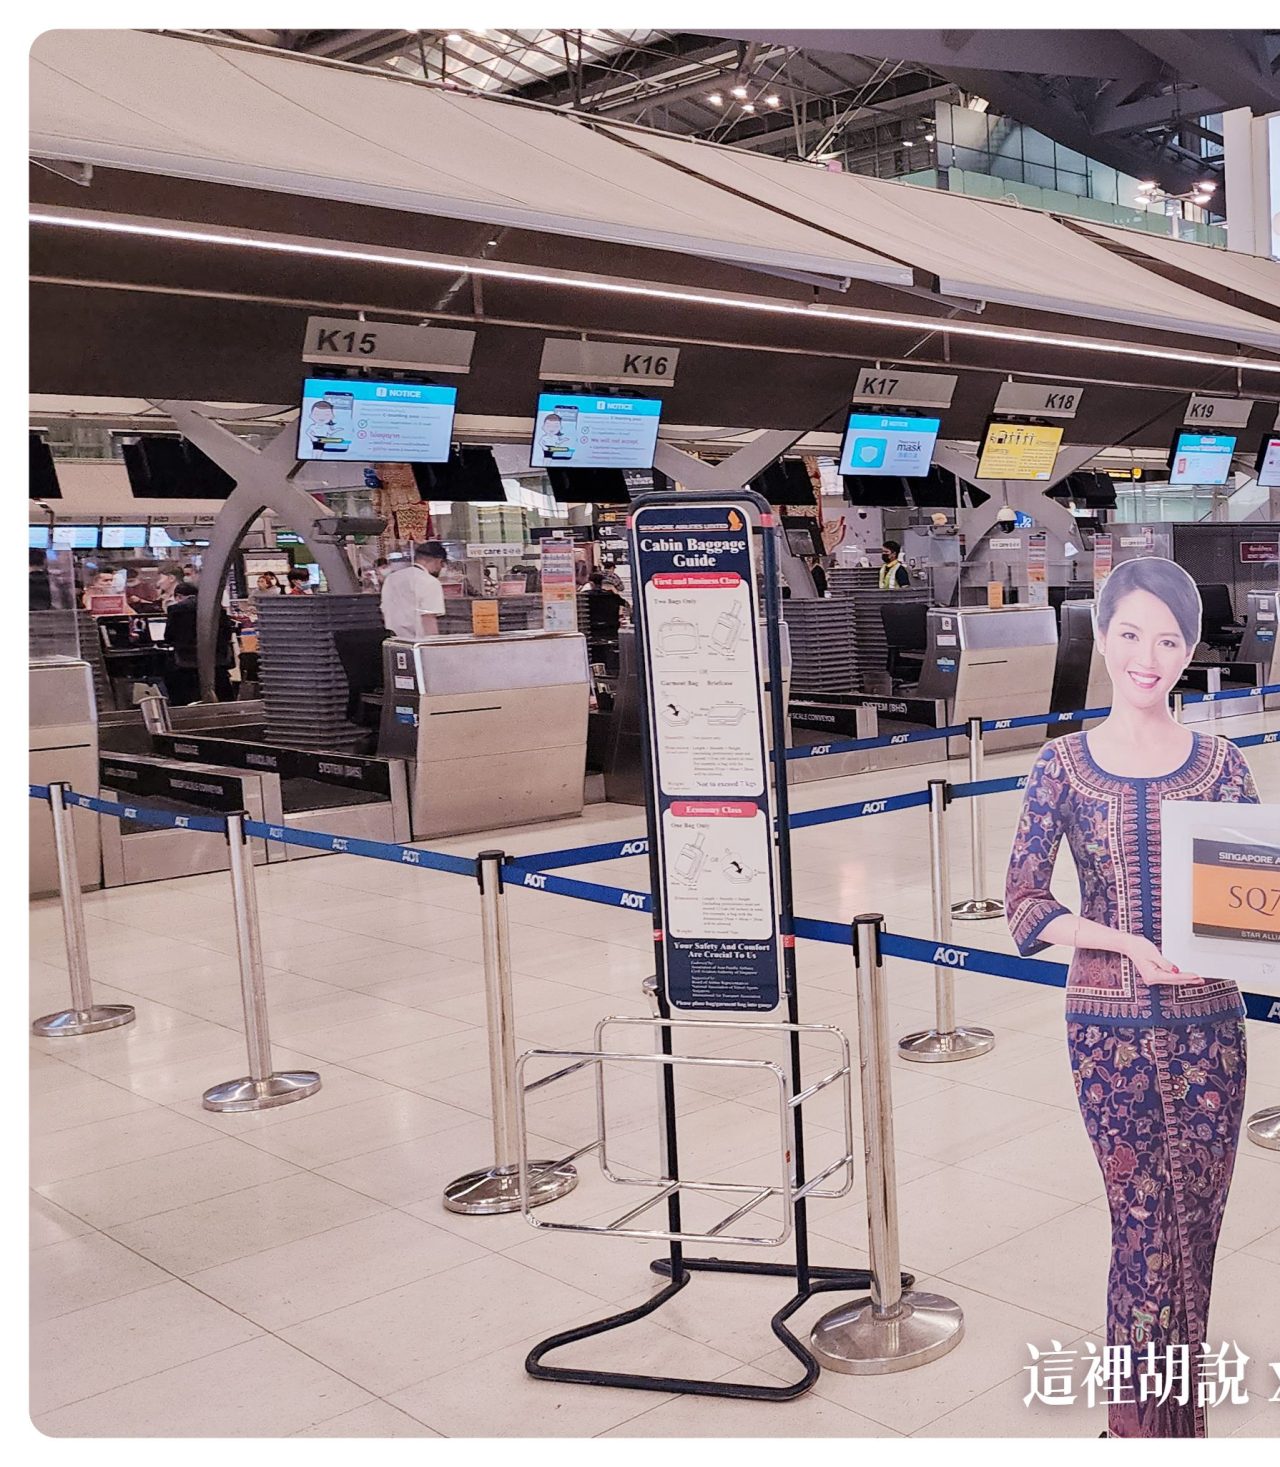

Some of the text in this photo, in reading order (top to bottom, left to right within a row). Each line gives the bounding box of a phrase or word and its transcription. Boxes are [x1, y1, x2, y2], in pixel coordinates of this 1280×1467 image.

[316, 328, 376, 355] K15
[622, 353, 669, 376] K16
[861, 377, 899, 395] K17
[389, 389, 422, 398] NOTICE
[1045, 393, 1075, 410] K18
[1190, 403, 1214, 419] K19
[897, 441, 921, 452] mask
[640, 537, 746, 554] Cabin Baggage
[673, 554, 717, 567] Guide
[719, 577, 740, 585] Class
[808, 713, 836, 723] CONVEYOR
[1058, 712, 1074, 721] AOT
[995, 720, 1012, 729] AOT
[890, 733, 910, 744] AOT
[811, 745, 831, 755] AOT
[685, 805, 742, 815] Economy Class
[862, 801, 888, 815] AOT
[332, 837, 349, 852] AOT
[620, 840, 649, 856] AOT
[402, 849, 421, 864] AOT
[1219, 851, 1274, 864] SINGAPORE
[524, 872, 547, 889] AOT
[620, 892, 646, 909] AOT
[674, 942, 694, 950] Your
[694, 942, 719, 951] Safety
[738, 943, 770, 951] Comfort
[734, 951, 746, 959] To
[933, 947, 969, 967] AOT
